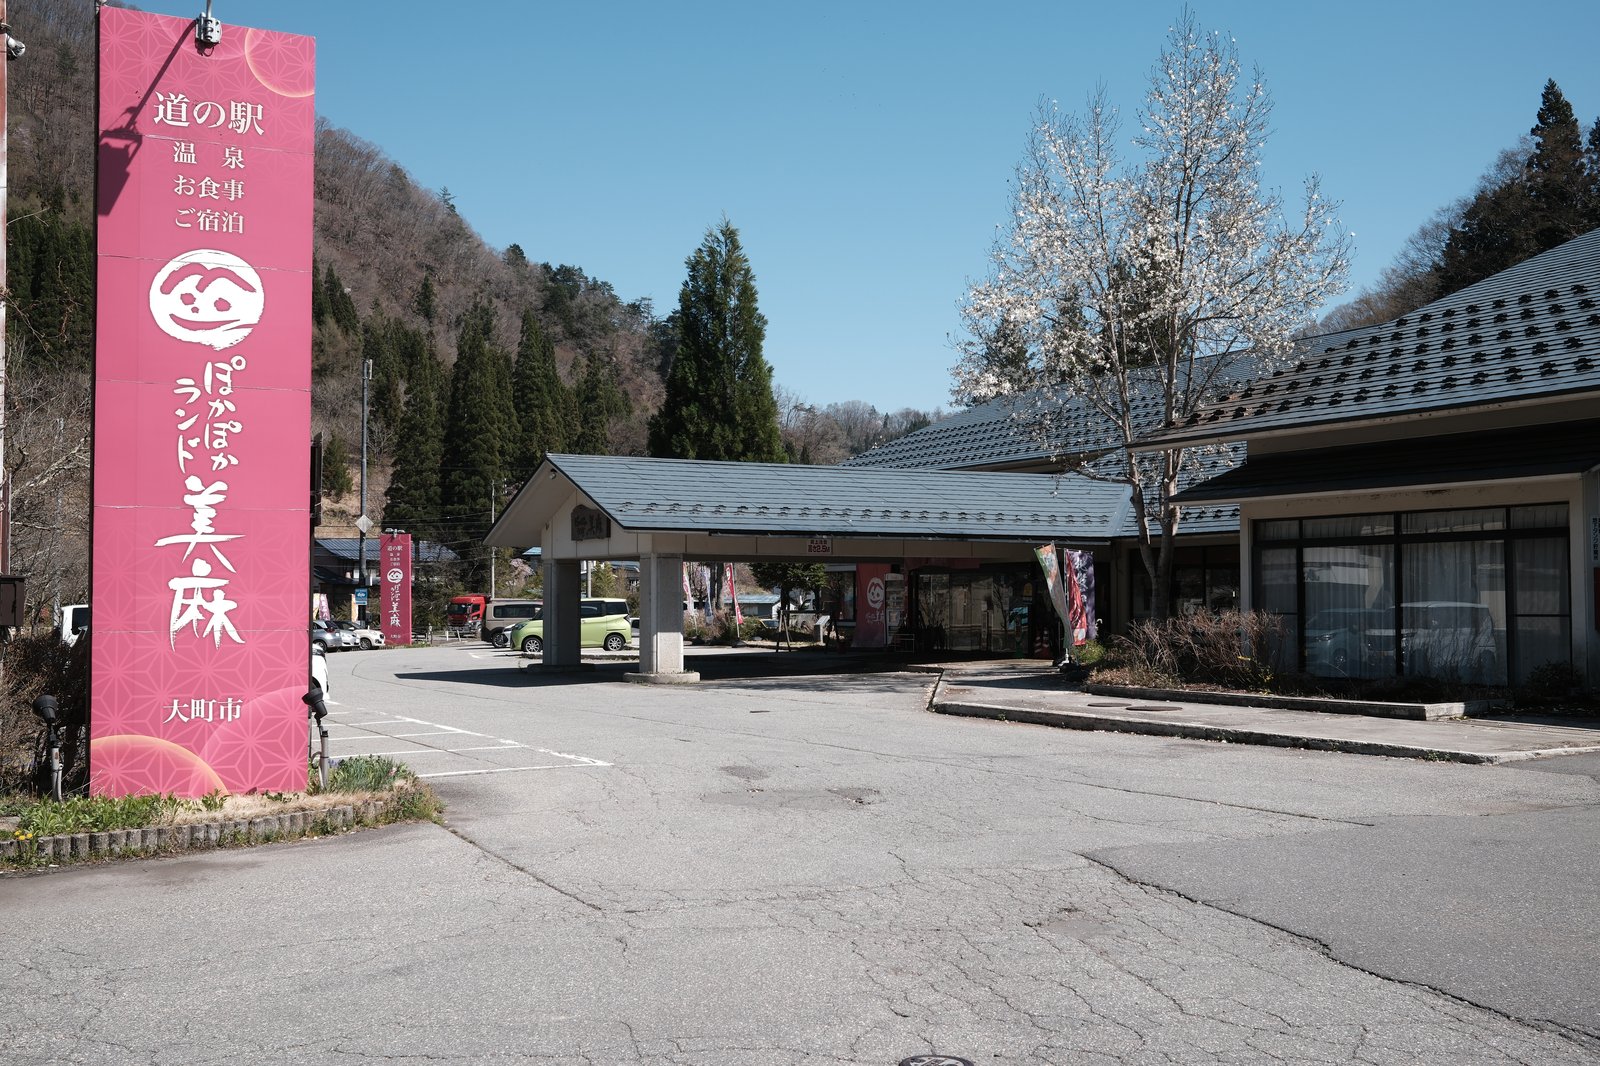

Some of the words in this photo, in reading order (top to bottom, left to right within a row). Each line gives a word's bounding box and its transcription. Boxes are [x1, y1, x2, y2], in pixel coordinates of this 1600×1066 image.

[153, 91, 265, 136] 道の駅
[173, 174, 245, 201] お食事
[175, 207, 244, 234] ご宿泊
[173, 377, 201, 474] ランド
[203, 355, 247, 471] ぽかぽか
[153, 475, 246, 652] 美麻
[162, 697, 244, 725] 大町市
